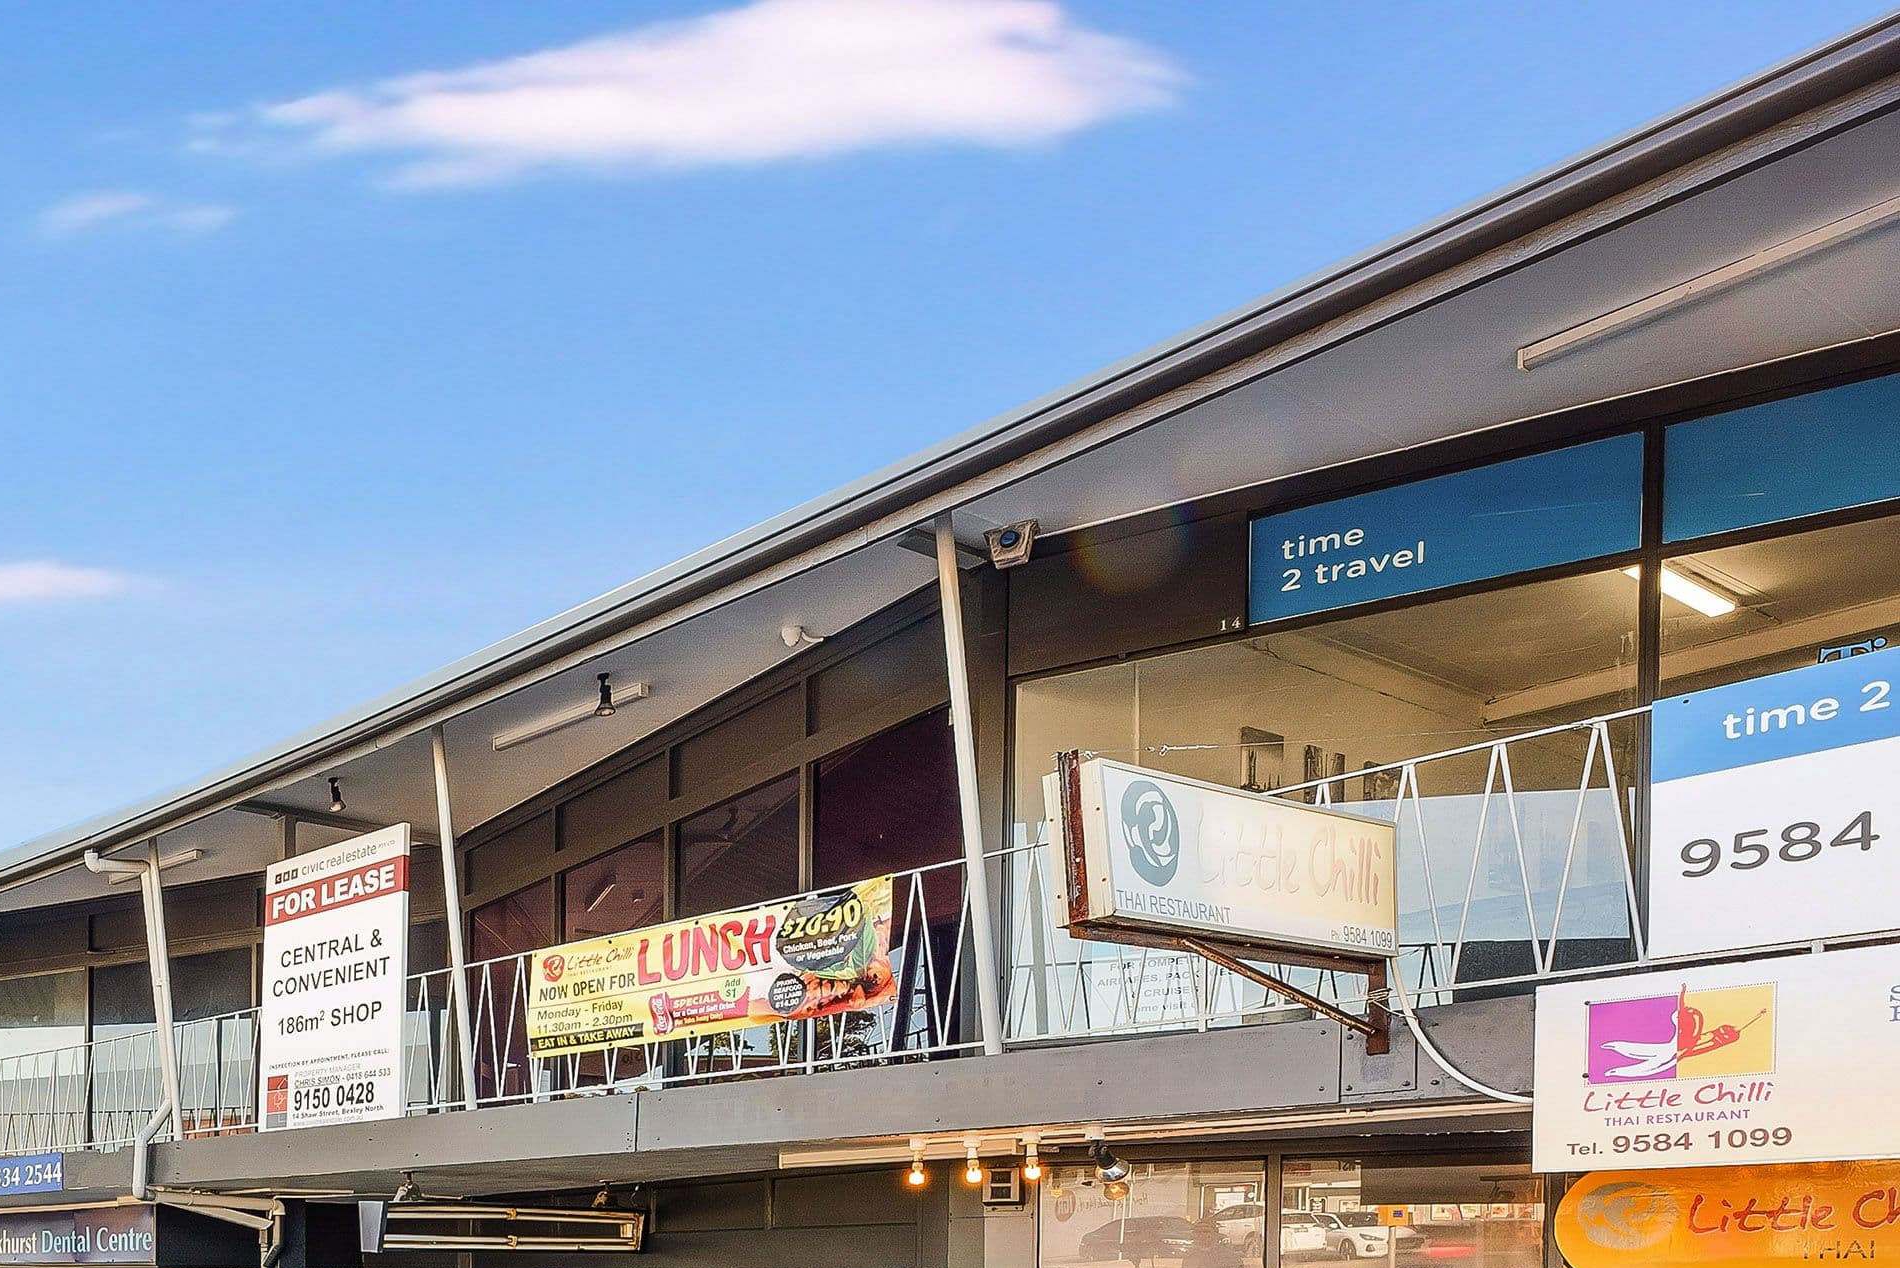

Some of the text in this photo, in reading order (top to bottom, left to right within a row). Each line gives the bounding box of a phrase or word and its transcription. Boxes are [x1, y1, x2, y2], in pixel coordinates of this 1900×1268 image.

[1281, 528, 1365, 560] time
[1280, 540, 1425, 592] 2 travel
[1722, 680, 1892, 740] time 2
[1680, 810, 1881, 878] 9584
[301, 859, 324, 876] CIVIC
[1308, 824, 1382, 906] Chilli
[271, 887, 317, 920] FOR
[320, 863, 396, 907] LEASE
[1115, 889, 1232, 925] THAI RESTAURANT
[280, 928, 383, 968] CENTRAL &
[838, 931, 858, 943] Pork
[1342, 925, 1367, 945] 9584
[1369, 929, 1393, 950] 1099
[539, 914, 777, 1002] NOW OPEN FOR LUNCH
[567, 946, 635, 971] Little Chilli
[795, 945, 845, 962] or Vegetable
[272, 955, 391, 998] CONVENIENT
[724, 977, 741, 988] Add
[672, 994, 717, 1009] SPECIAL
[725, 987, 737, 999] $1
[330, 1000, 382, 1027] SHOP
[537, 1007, 582, 1021] Monday
[592, 1000, 624, 1014] Friday
[537, 1022, 581, 1035] 11.30am
[592, 1013, 633, 1028] 2.30pm
[537, 1026, 636, 1049] EAT IN & TAKE AWAY
[268, 1061, 301, 1070] INSPECTION
[350, 1050, 372, 1059] PLEASE
[294, 1067, 328, 1078] PROPERTY
[294, 1081, 375, 1112] 9150 0428
[1582, 1081, 1775, 1113] Little Chilli
[300, 1111, 318, 1119] Shaw
[341, 1106, 364, 1116] Bexley
[364, 1104, 385, 1112] North
[1604, 1109, 1751, 1127] THAI RESTAURANT
[1566, 1126, 1793, 1156] Tel. 9584 1099
[23, 1162, 63, 1187] 2544
[1688, 1194, 1836, 1235] Little
[41, 1226, 91, 1254] Dental
[96, 1226, 153, 1253] Centre
